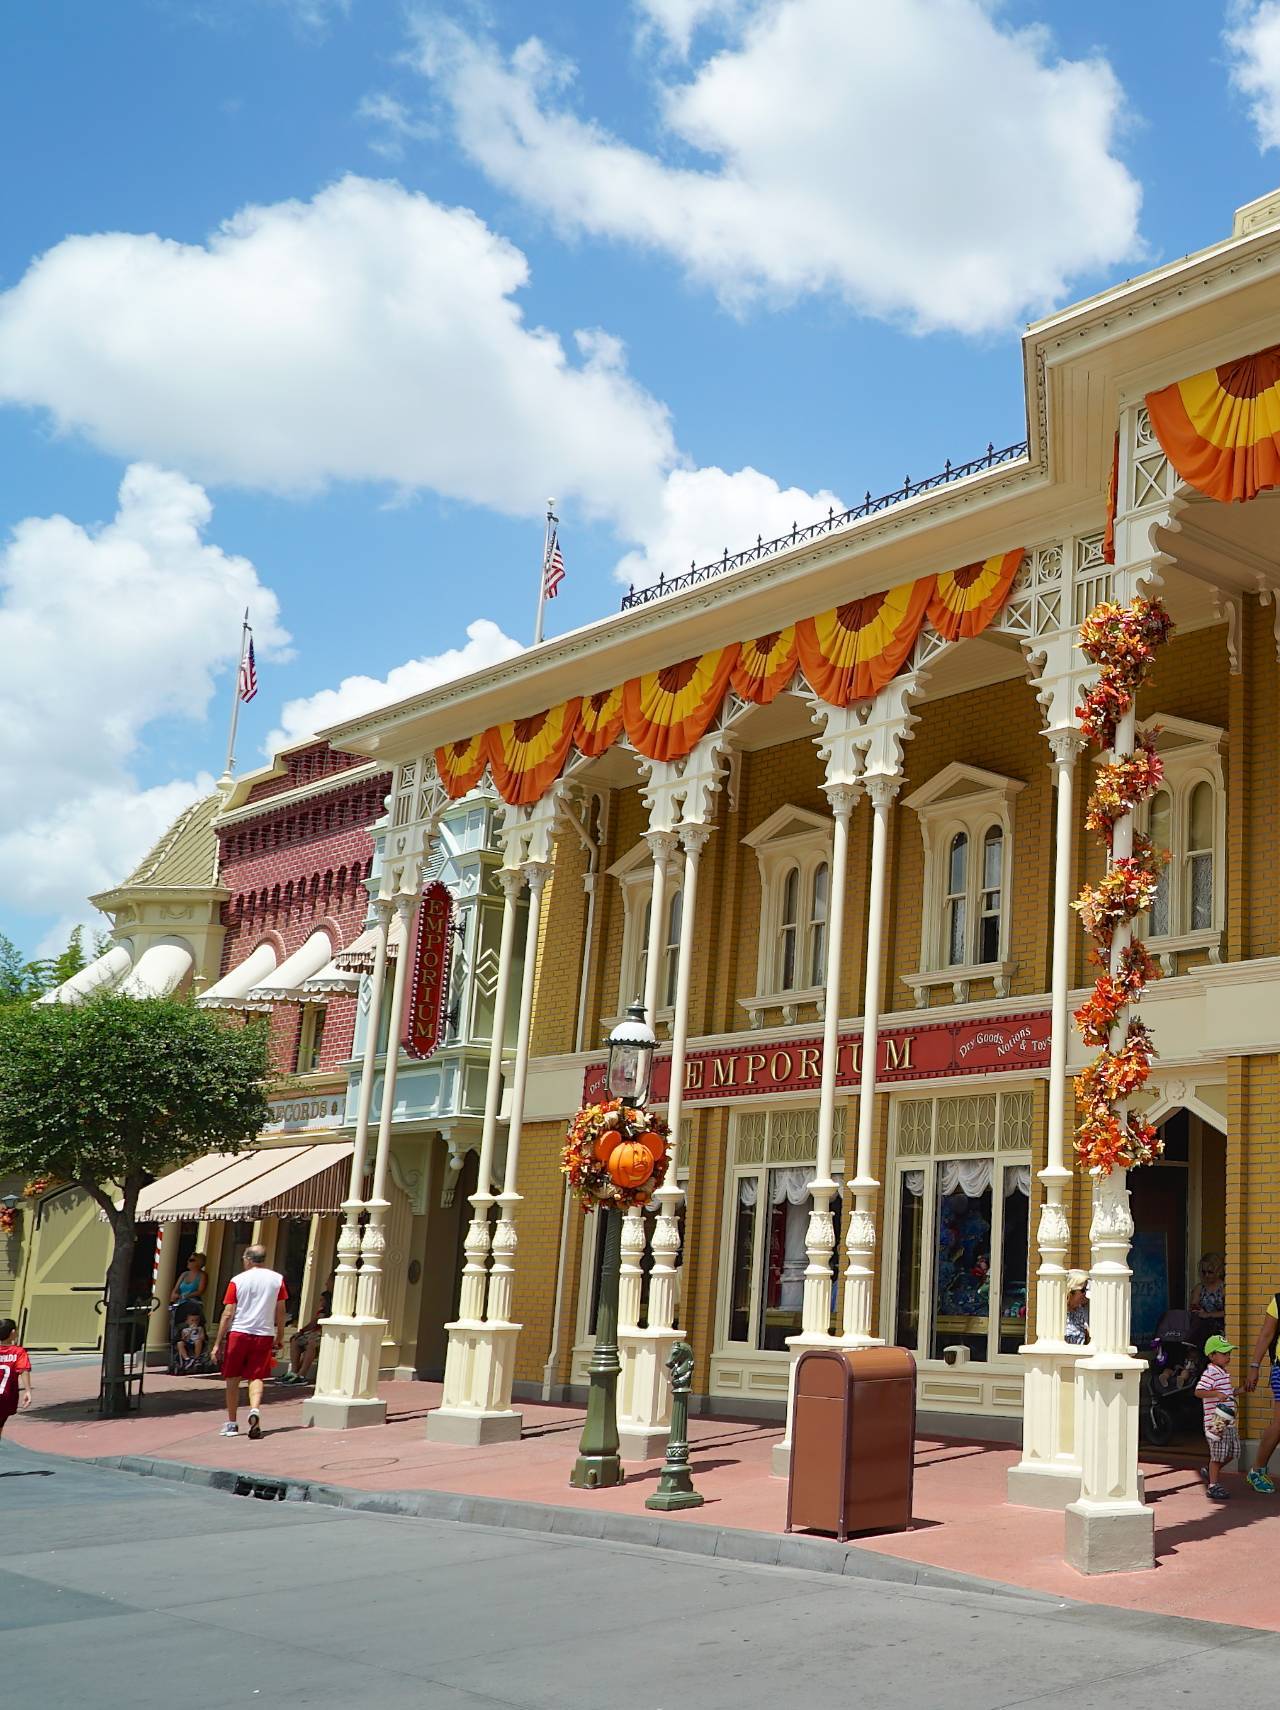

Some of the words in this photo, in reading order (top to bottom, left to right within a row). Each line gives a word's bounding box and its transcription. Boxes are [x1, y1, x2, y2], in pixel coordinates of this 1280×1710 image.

[414, 900, 445, 1039] EMPORIUM
[959, 1040, 976, 1058] Dry
[976, 1033, 1004, 1044] Goods
[997, 1026, 1031, 1056] Notions
[1019, 1040, 1027, 1051] &
[1032, 1036, 1052, 1051] Toys
